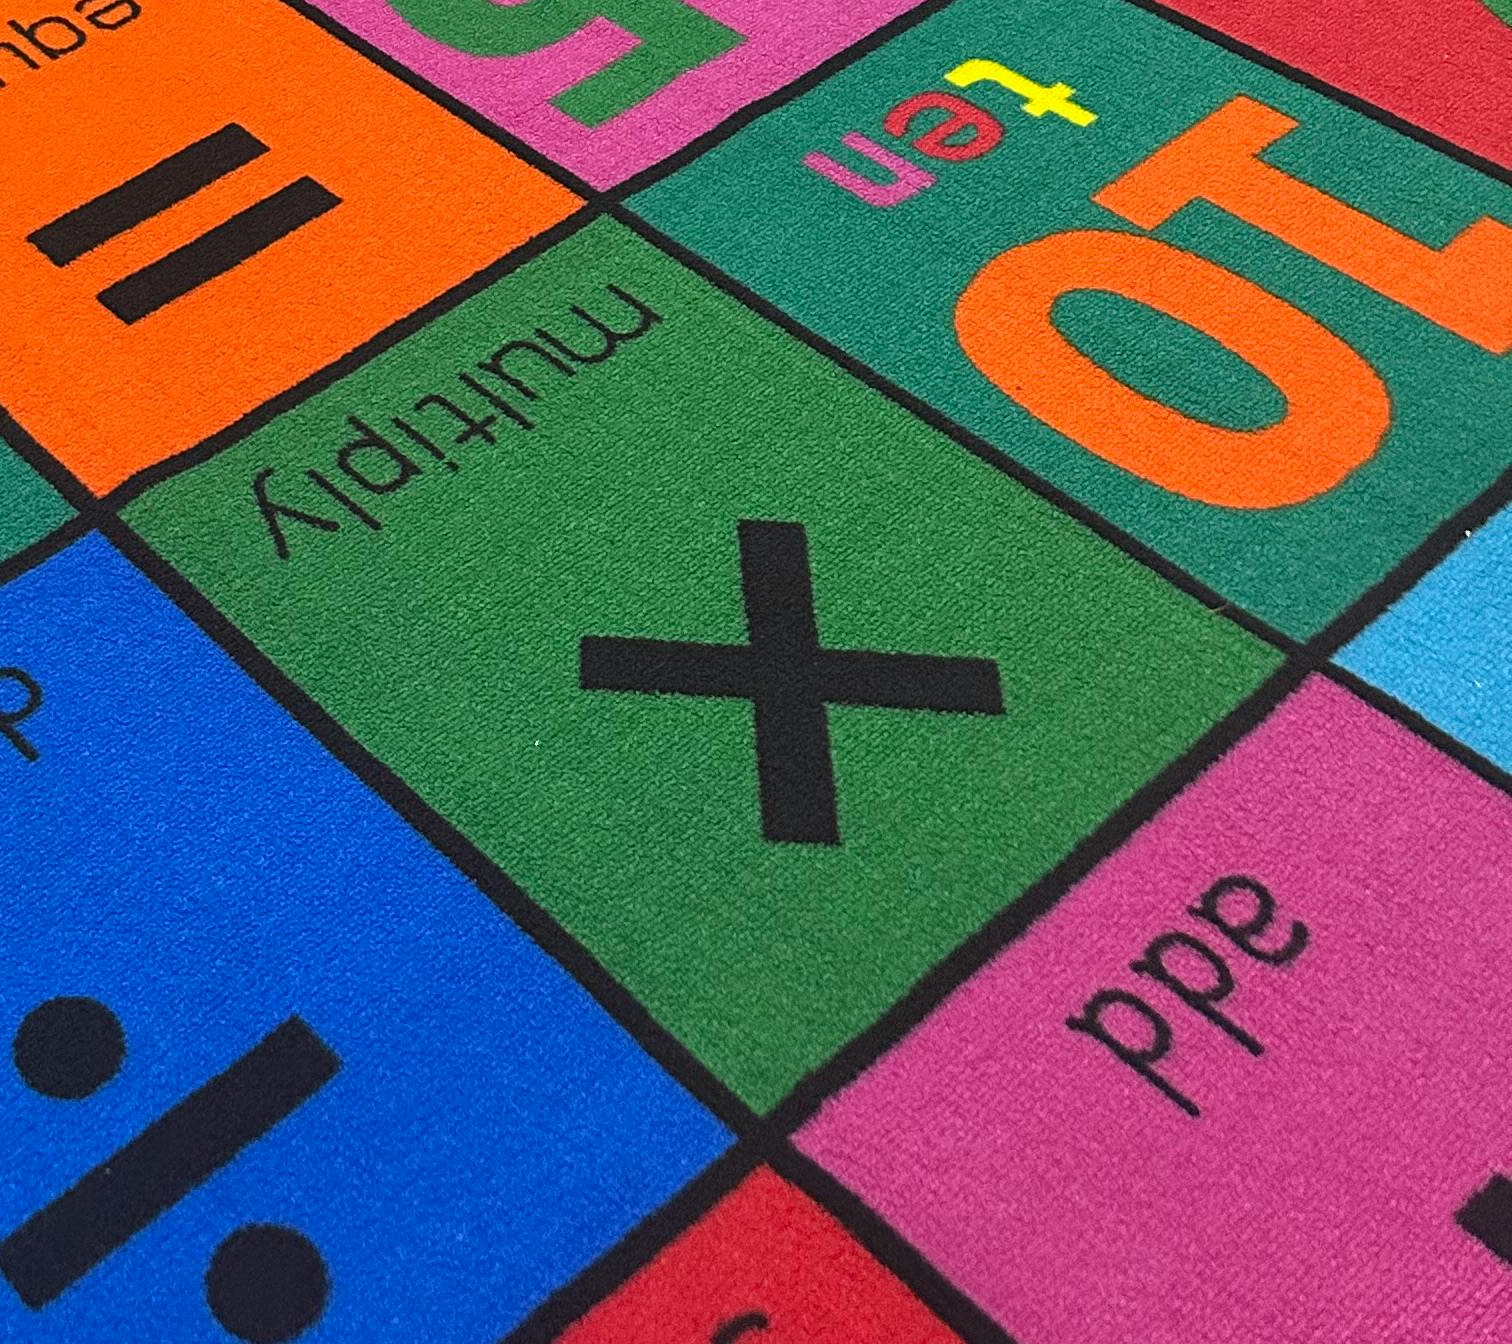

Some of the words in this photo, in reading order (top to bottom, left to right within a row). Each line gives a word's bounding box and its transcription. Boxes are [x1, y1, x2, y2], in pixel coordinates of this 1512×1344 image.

[801, 57, 1098, 208] ten
[250, 281, 662, 560] multiply
[953, 93, 1512, 510] 10
[1064, 872, 1311, 1118] add
